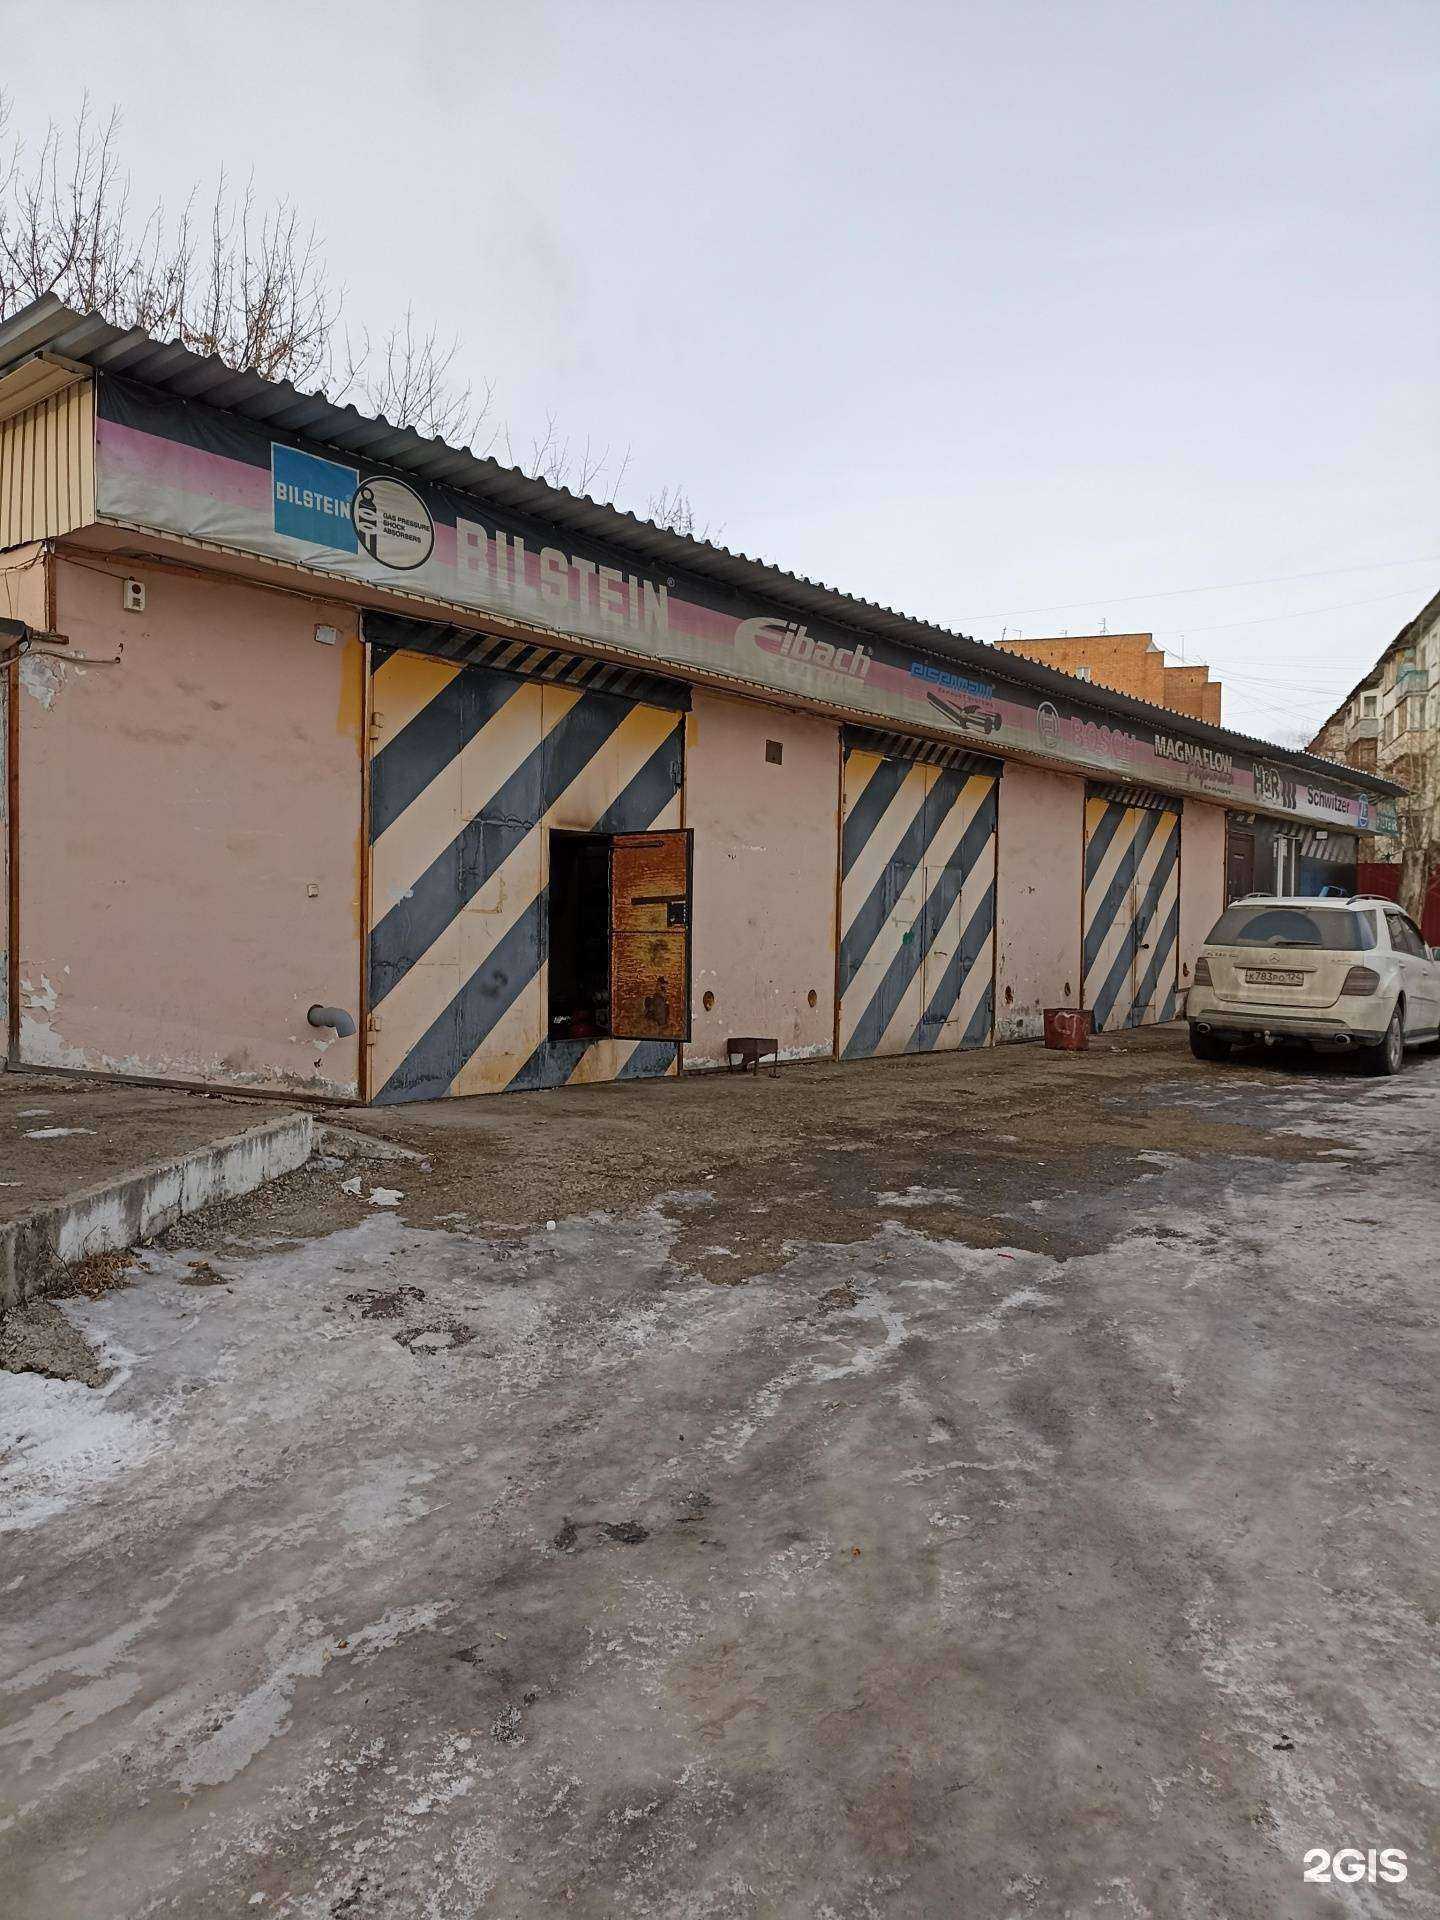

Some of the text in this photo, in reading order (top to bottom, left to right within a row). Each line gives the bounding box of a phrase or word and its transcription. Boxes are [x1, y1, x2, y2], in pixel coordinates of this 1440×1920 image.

[276, 481, 350, 520] BILSTEIN
[382, 512, 430, 532] GAS PRESSURE
[382, 520, 406, 531] SHOCK
[382, 528, 422, 544] ABSORBERS
[734, 616, 871, 678] Eibach
[1070, 716, 1137, 759] BOSCH
[1307, 784, 1350, 814] Schwitzer
